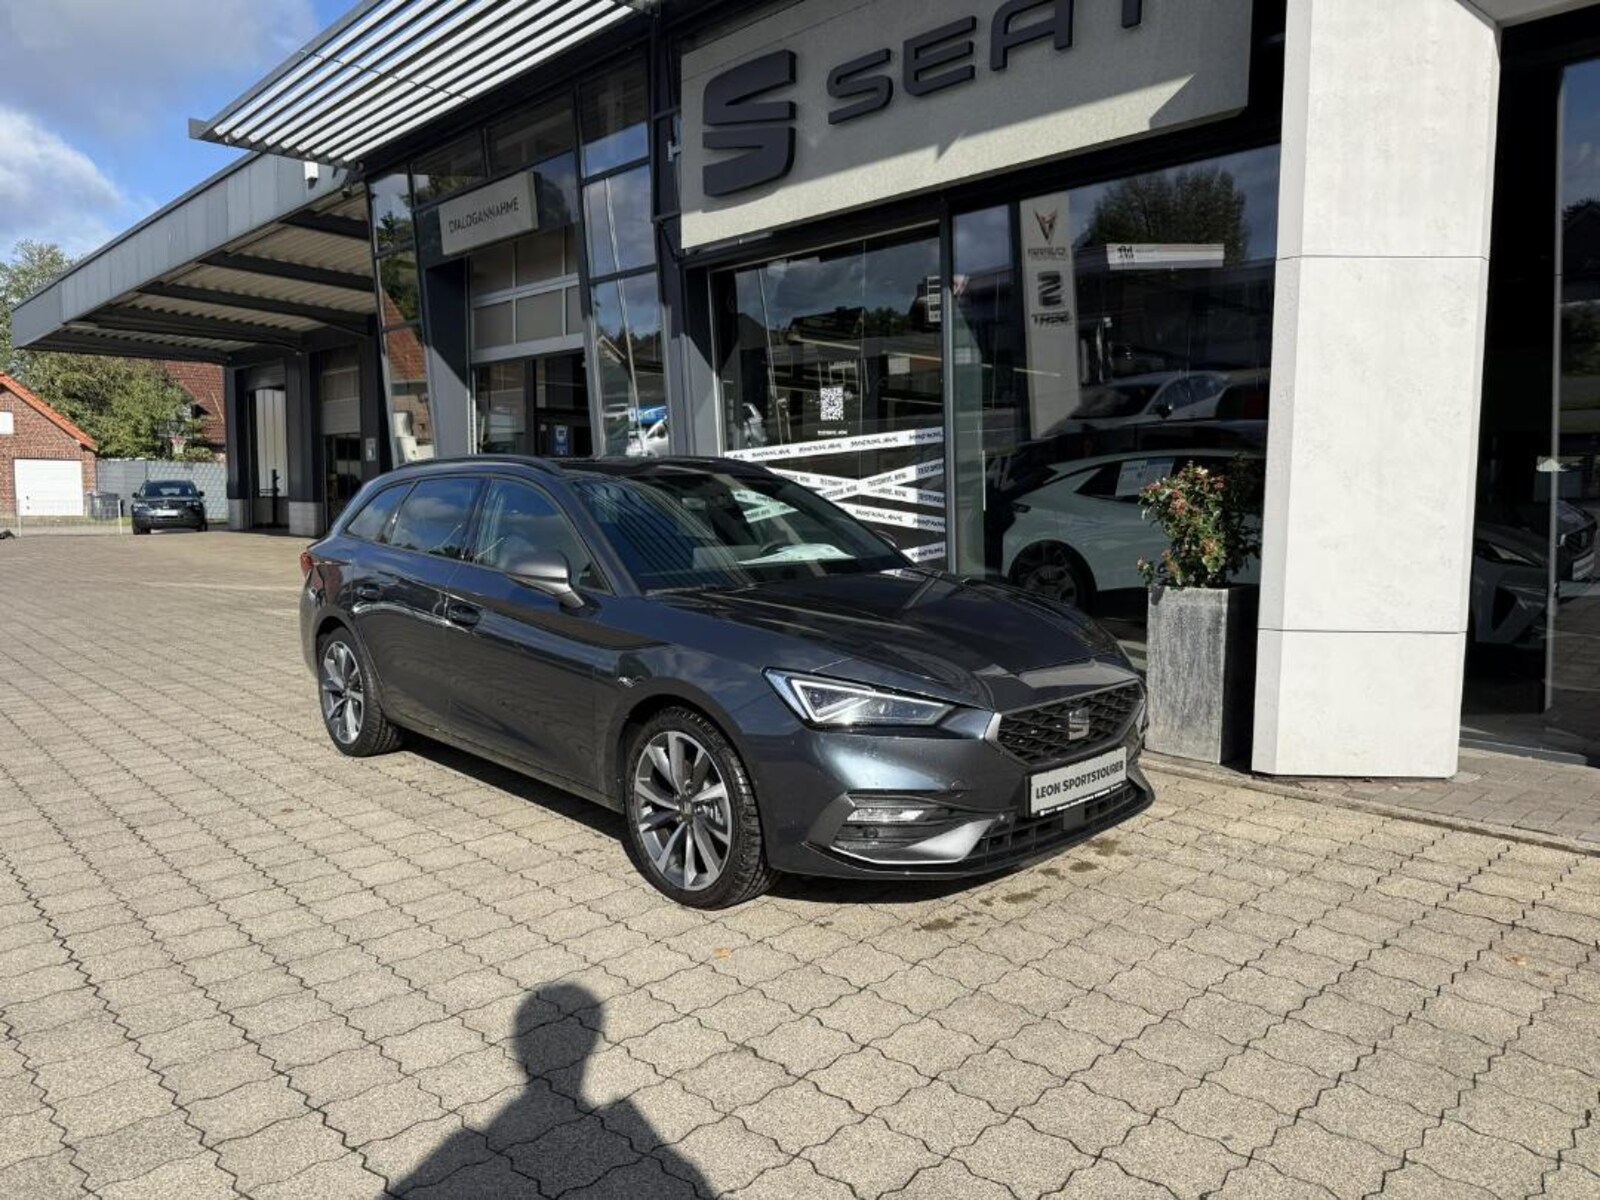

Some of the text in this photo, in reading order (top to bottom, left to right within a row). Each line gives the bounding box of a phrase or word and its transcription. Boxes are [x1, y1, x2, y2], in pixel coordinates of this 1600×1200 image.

[448, 197, 520, 234] DIALOGANNAHME
[1036, 761, 1124, 799] LEON SPORTSTOURER
